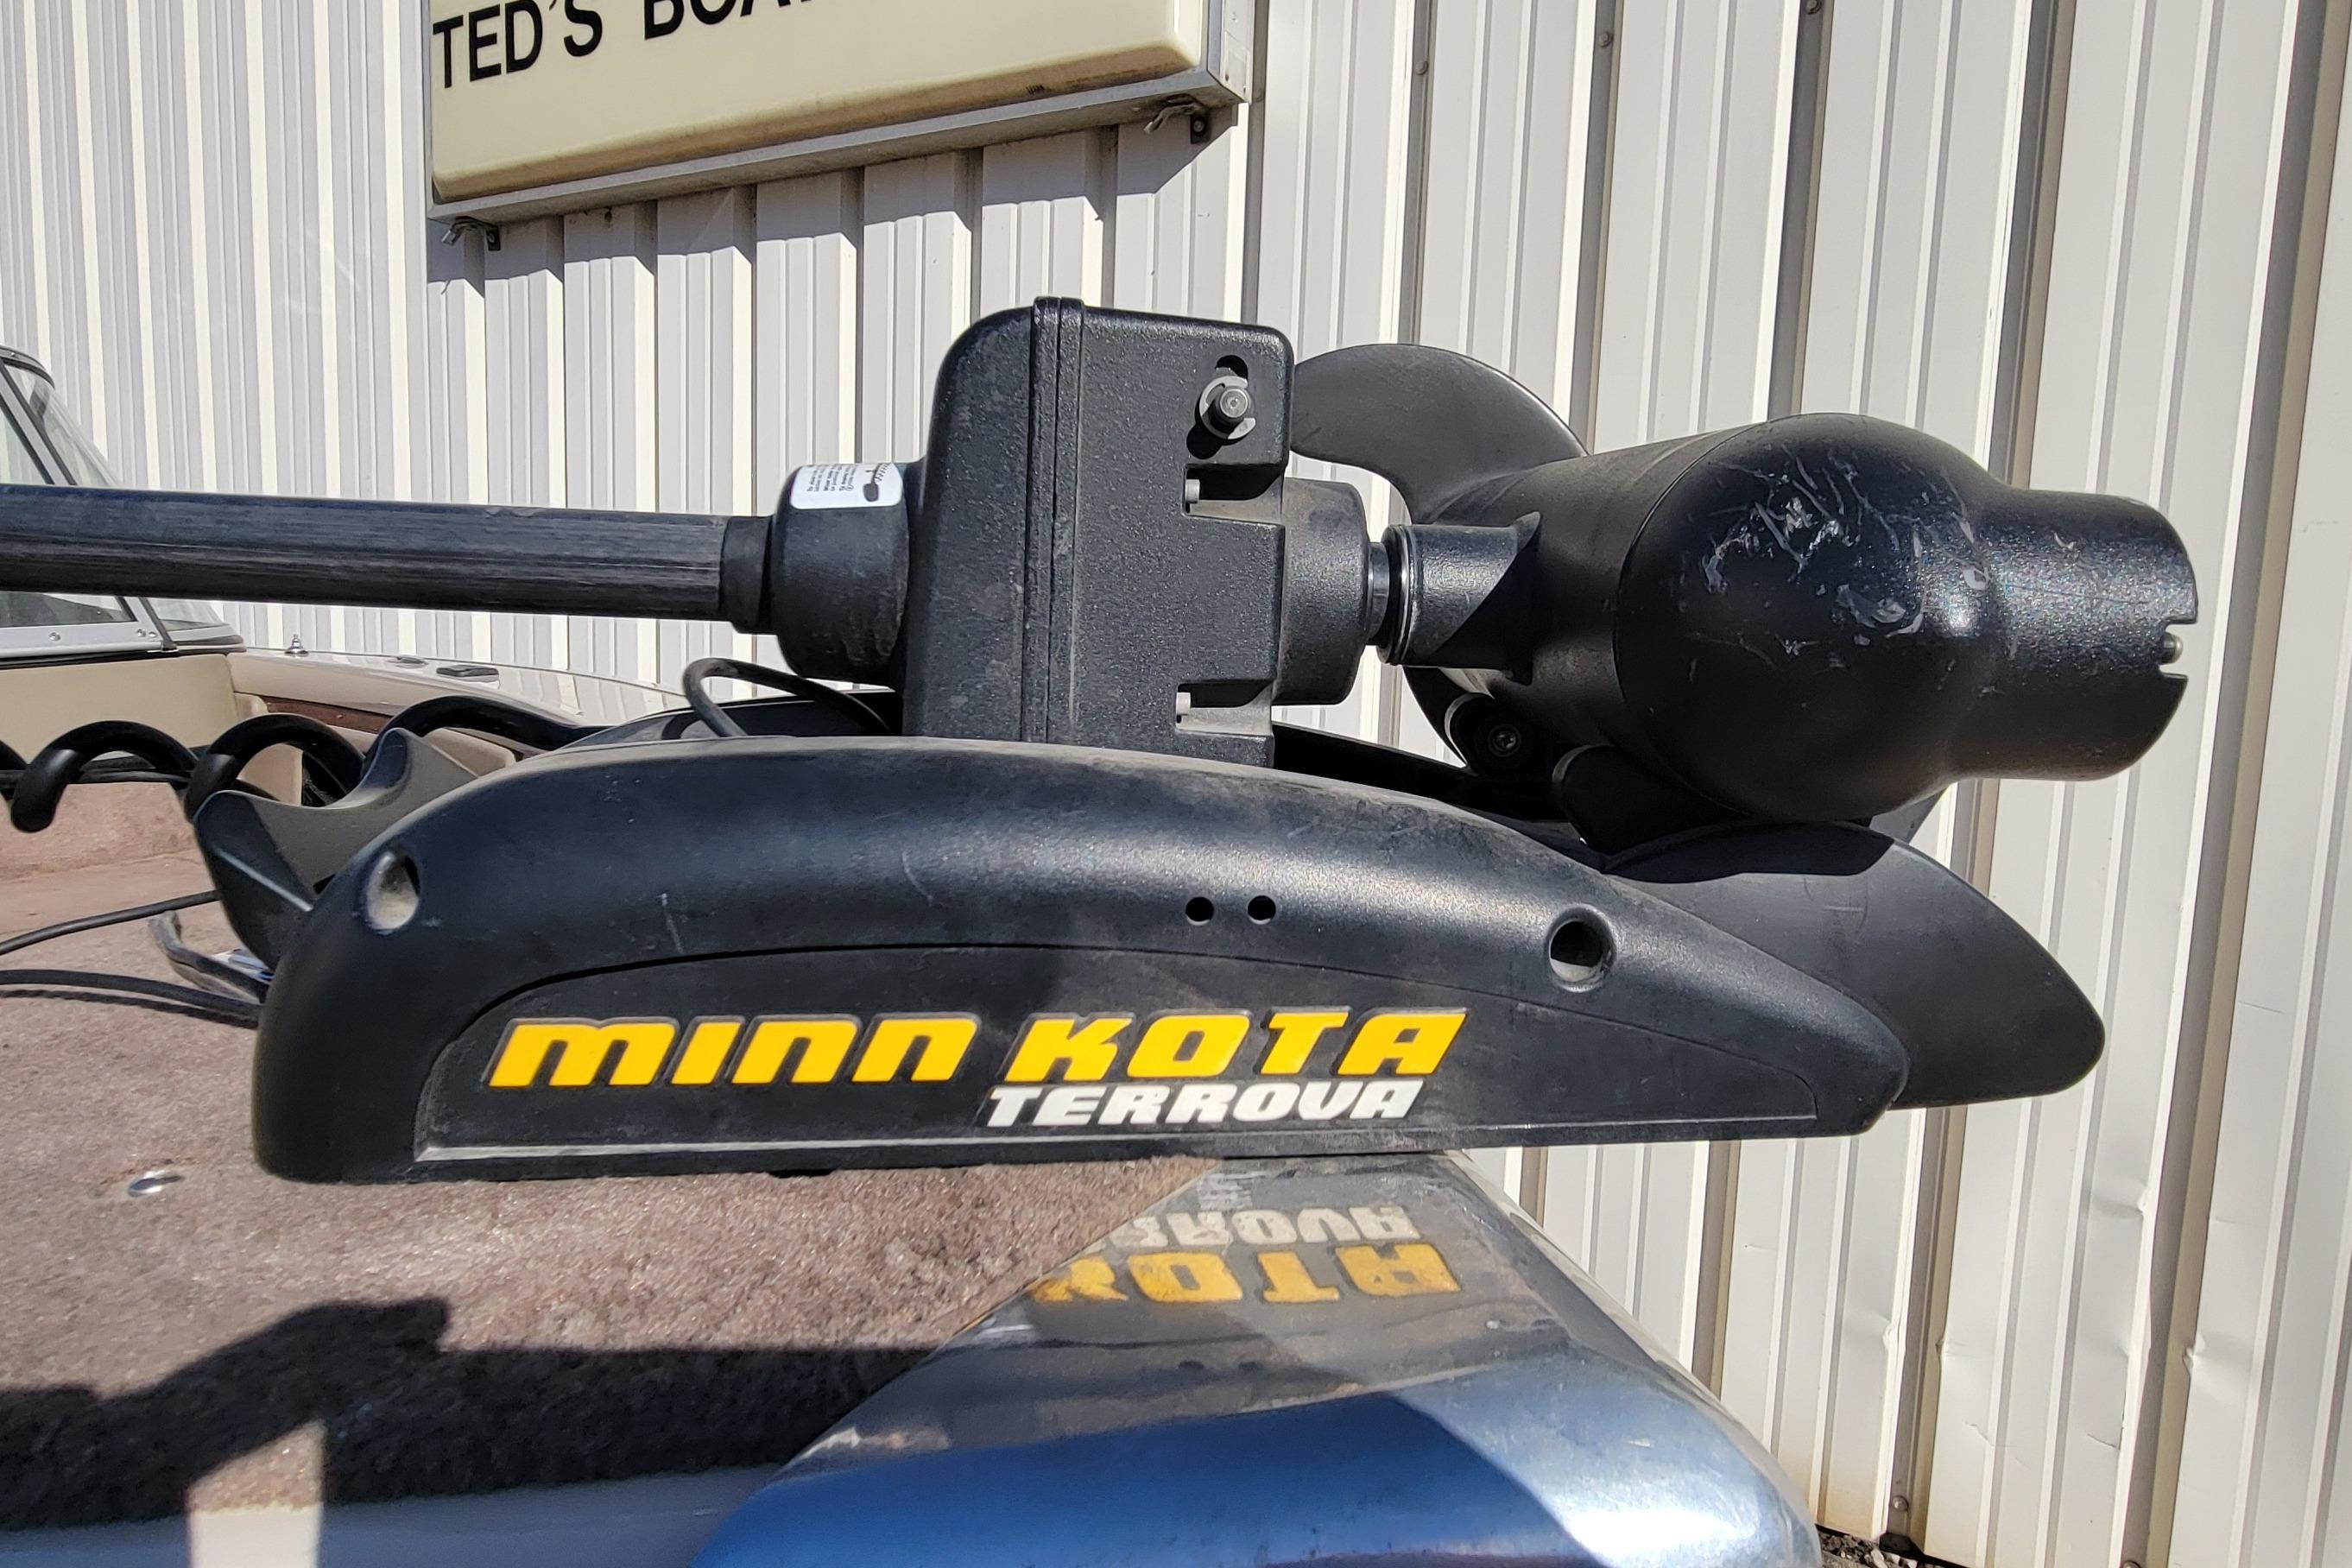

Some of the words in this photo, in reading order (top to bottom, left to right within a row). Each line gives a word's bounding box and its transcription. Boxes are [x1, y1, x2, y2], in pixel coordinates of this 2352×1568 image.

[487, 1018, 978, 1088] MINN
[1002, 1012, 1466, 1083] KOTA
[986, 1078, 1424, 1128] TERROVA
